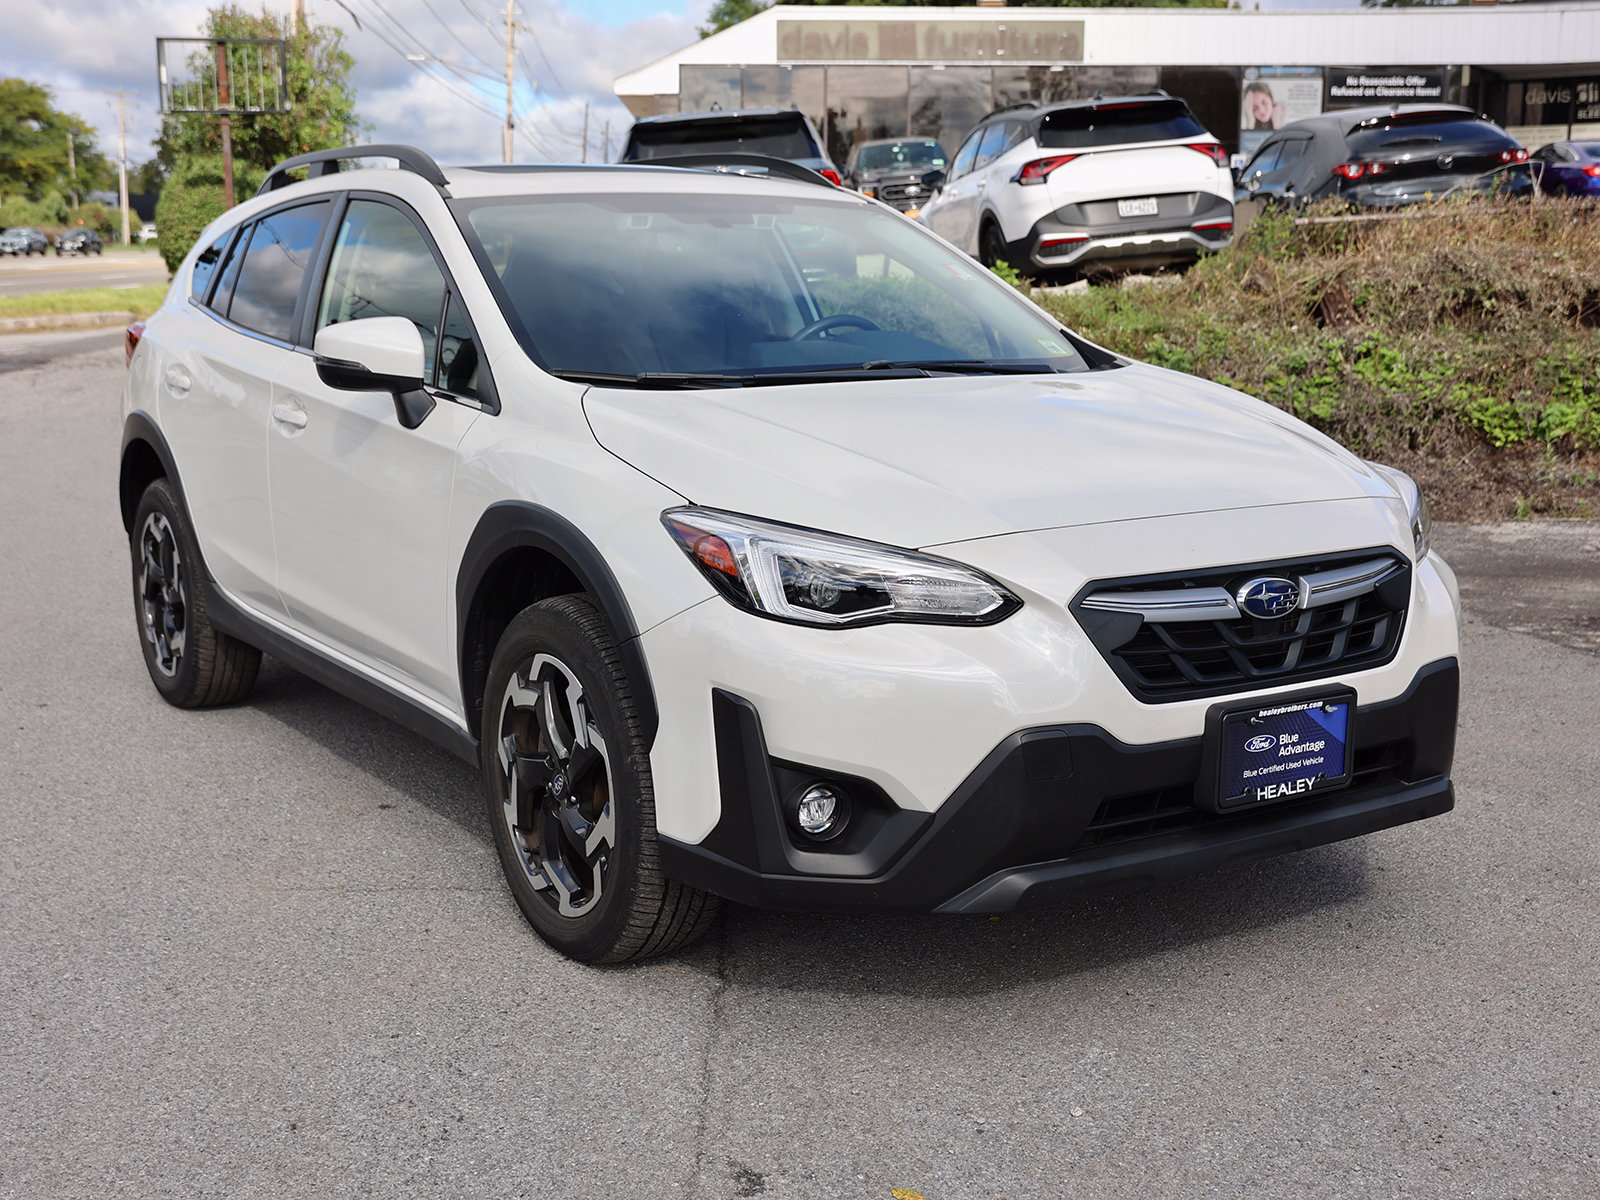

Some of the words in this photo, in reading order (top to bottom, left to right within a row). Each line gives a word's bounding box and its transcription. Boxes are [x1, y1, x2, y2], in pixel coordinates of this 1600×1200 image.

[1346, 76, 1358, 86] No
[1360, 75, 1405, 87] Reasonable
[1405, 75, 1427, 86] Offer
[1331, 86, 1364, 96] Refused
[1364, 87, 1376, 96] on
[1376, 86, 1415, 96] Clearance
[1525, 88, 1571, 105] davis
[1258, 701, 1323, 717] healeybrothers.com
[1250, 737, 1271, 750] Ford
[1279, 733, 1299, 745] Blue
[1278, 740, 1325, 757] Advantage
[1243, 769, 1258, 778] Blue
[1258, 763, 1285, 775] Certified
[1285, 760, 1302, 770] Used
[1302, 756, 1324, 766] Vehicle
[1257, 777, 1316, 801] HEALEY
